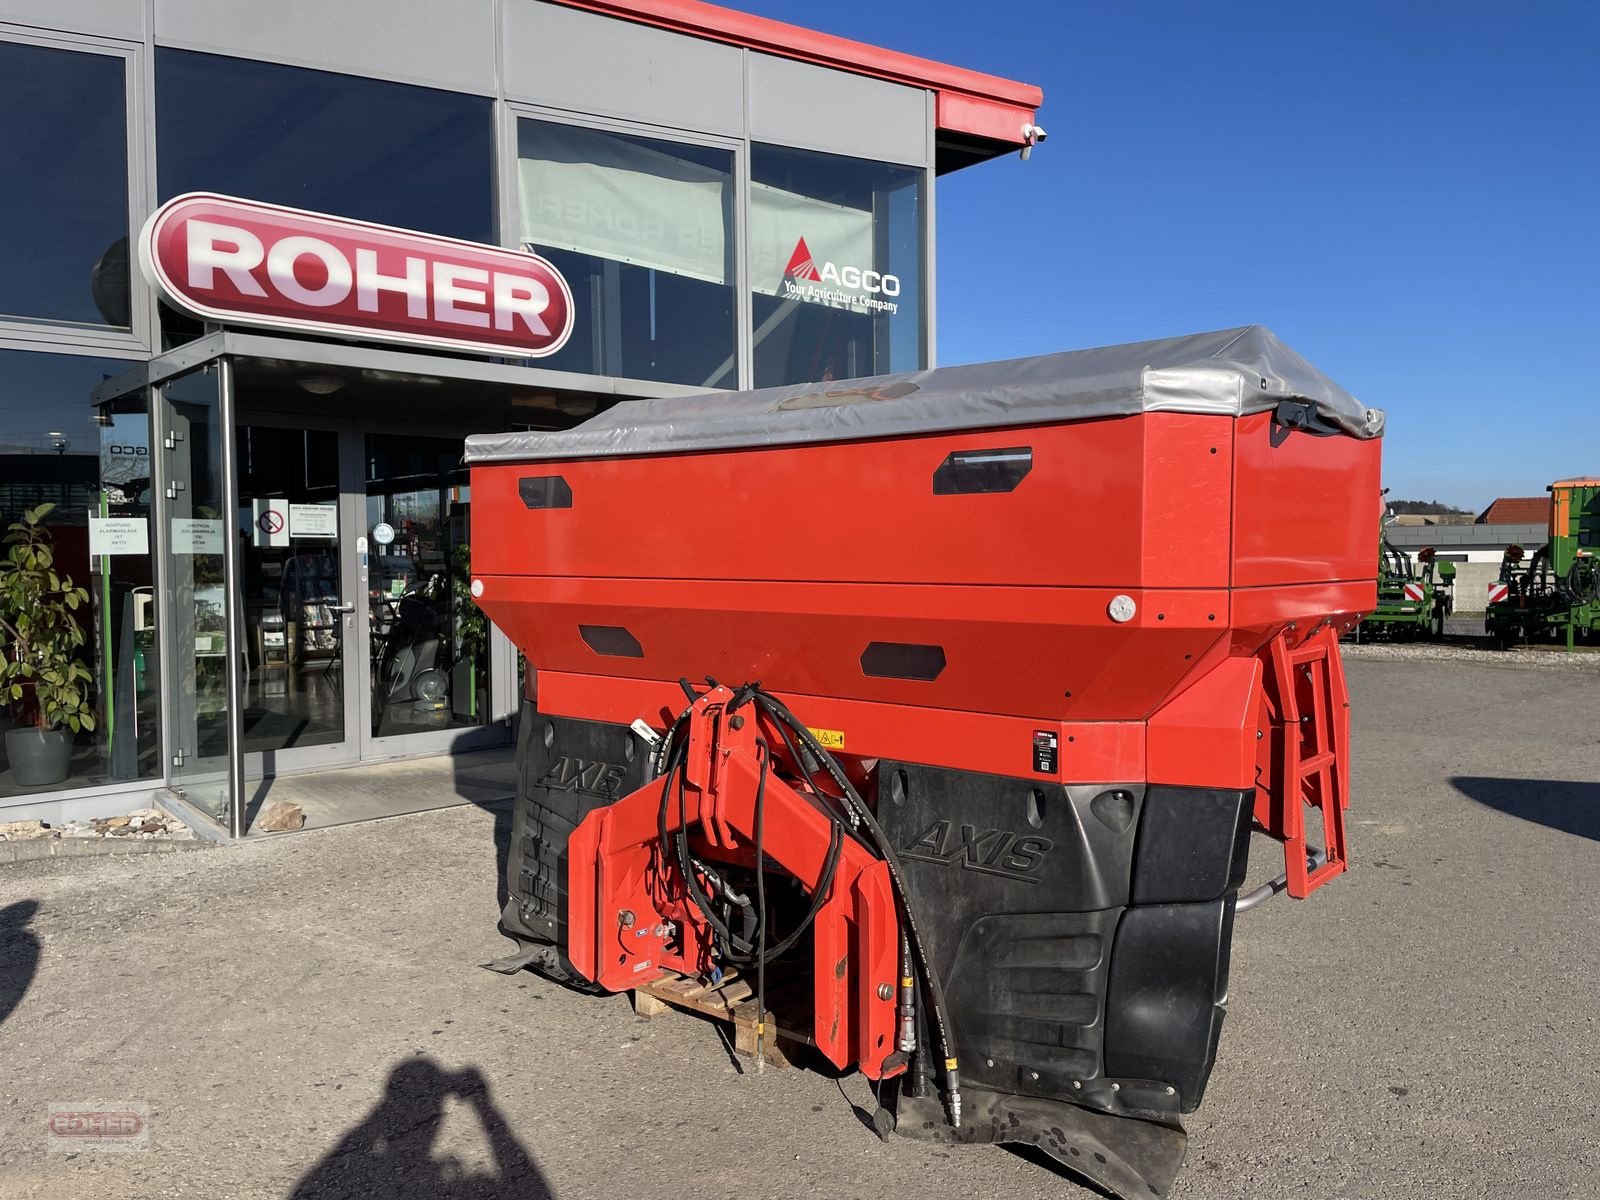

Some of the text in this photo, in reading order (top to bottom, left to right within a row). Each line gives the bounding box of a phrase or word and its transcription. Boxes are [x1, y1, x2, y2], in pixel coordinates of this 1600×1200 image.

[186, 218, 552, 337] ROHER
[821, 261, 901, 297] AGCO
[784, 280, 898, 315] Your Agriculture Company
[542, 756, 627, 793] AXIS
[902, 819, 1054, 873] AXIS
